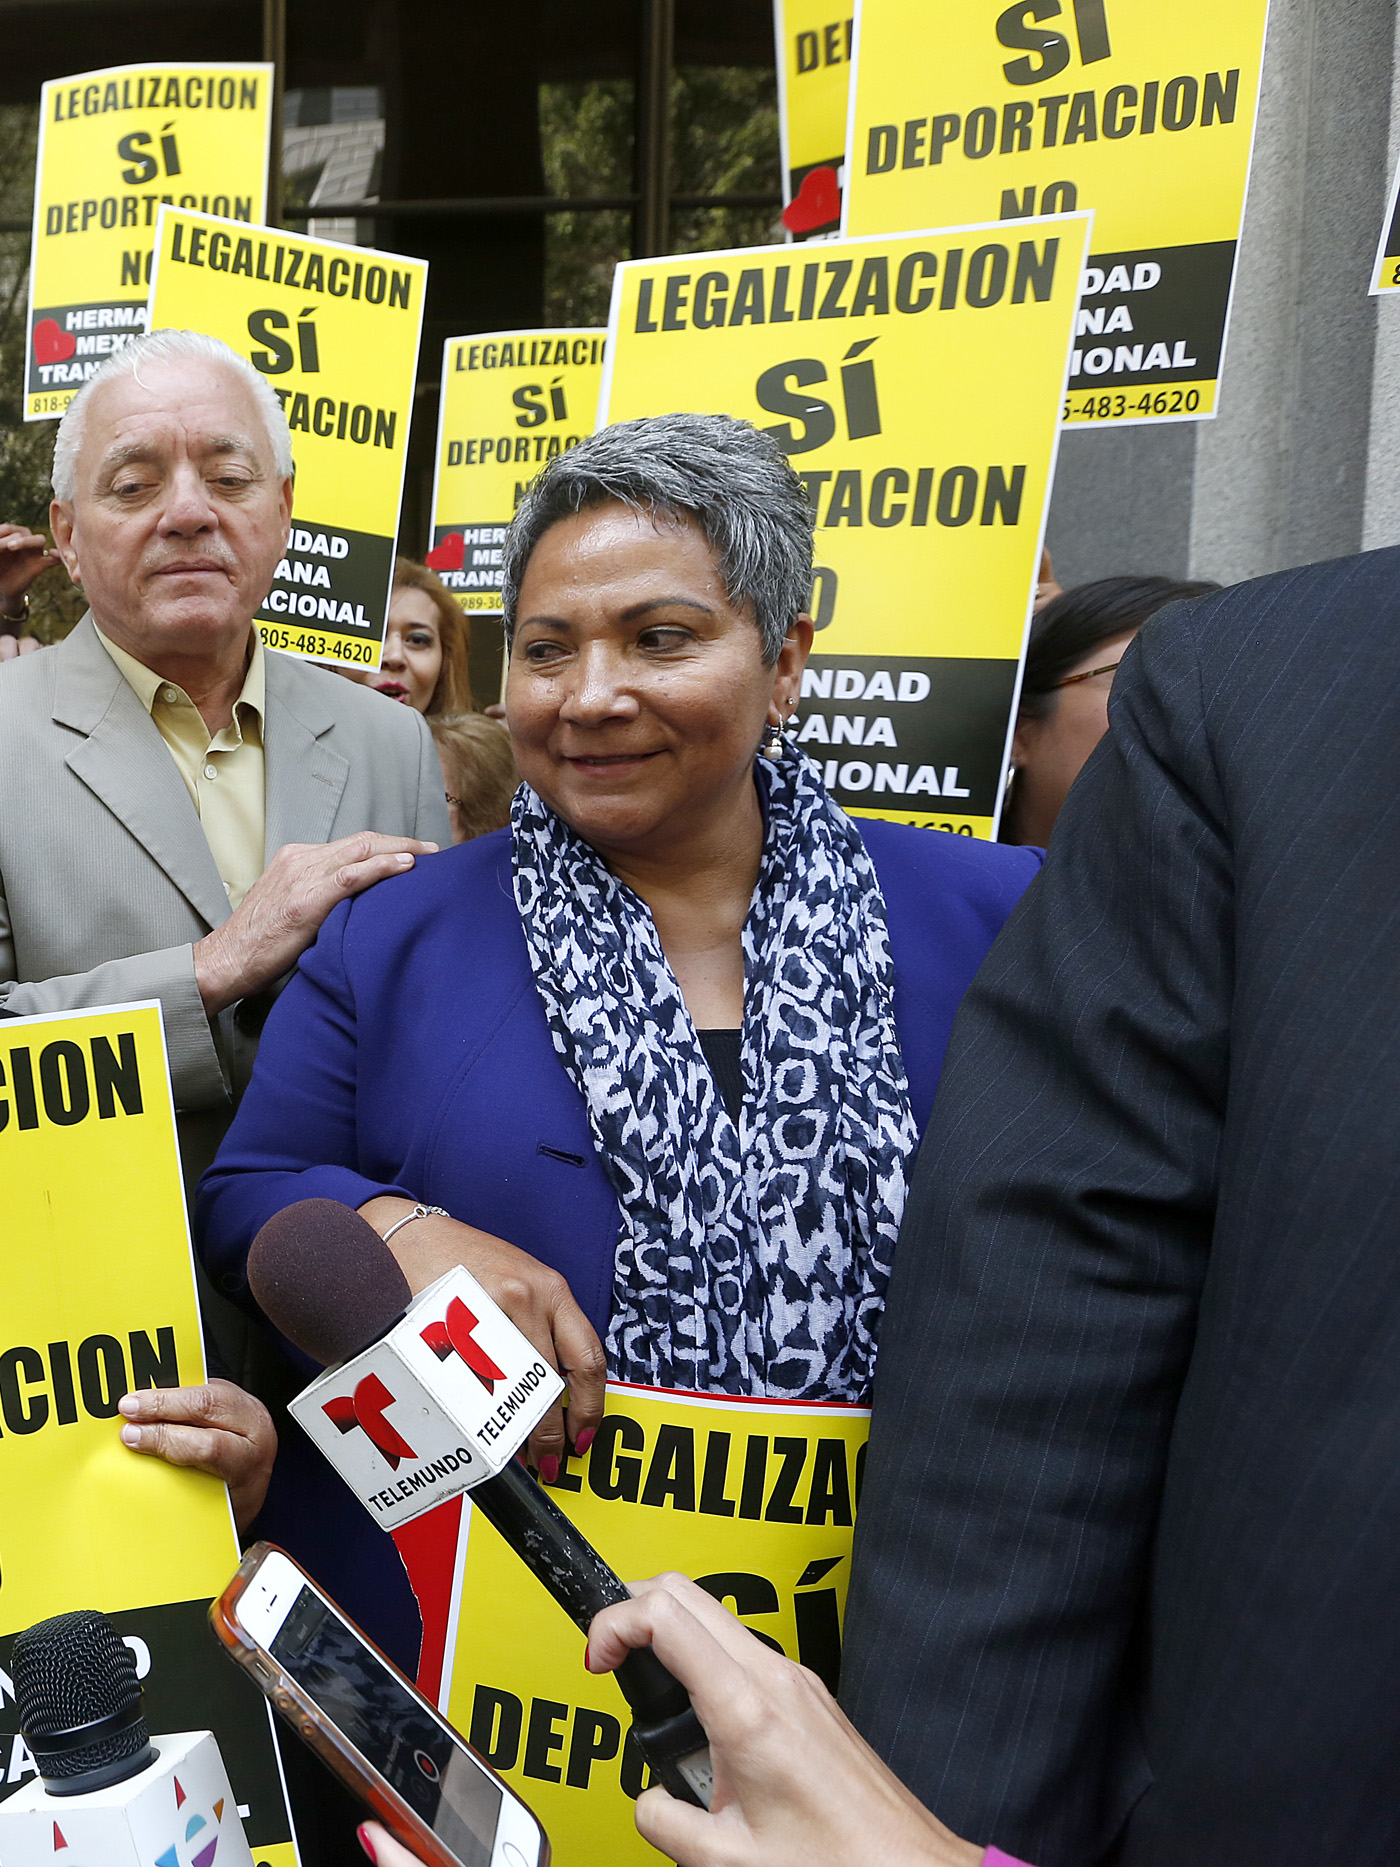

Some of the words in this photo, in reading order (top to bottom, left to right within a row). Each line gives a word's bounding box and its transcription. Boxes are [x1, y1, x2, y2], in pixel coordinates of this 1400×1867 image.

[54, 77, 258, 123] LEGALIZACION
[866, 68, 1241, 176] DEPORTACION
[116, 120, 182, 185] SÍ
[170, 222, 412, 311] LEGALIZACION
[634, 236, 1062, 334] LEGALIZACION
[246, 305, 321, 375] SÍ
[274, 387, 398, 450] TACION
[512, 374, 568, 428] SÍ
[755, 335, 883, 456] SÍ
[799, 464, 1028, 528] TACION
[810, 565, 839, 633] O
[260, 627, 373, 664] 805-483-4620
[799, 668, 932, 703] NDAD
[476, 1361, 547, 1447] TELEMUNDO
[367, 1446, 473, 1512] TELEMUNDO
[528, 1414, 867, 1528] GALIZA
